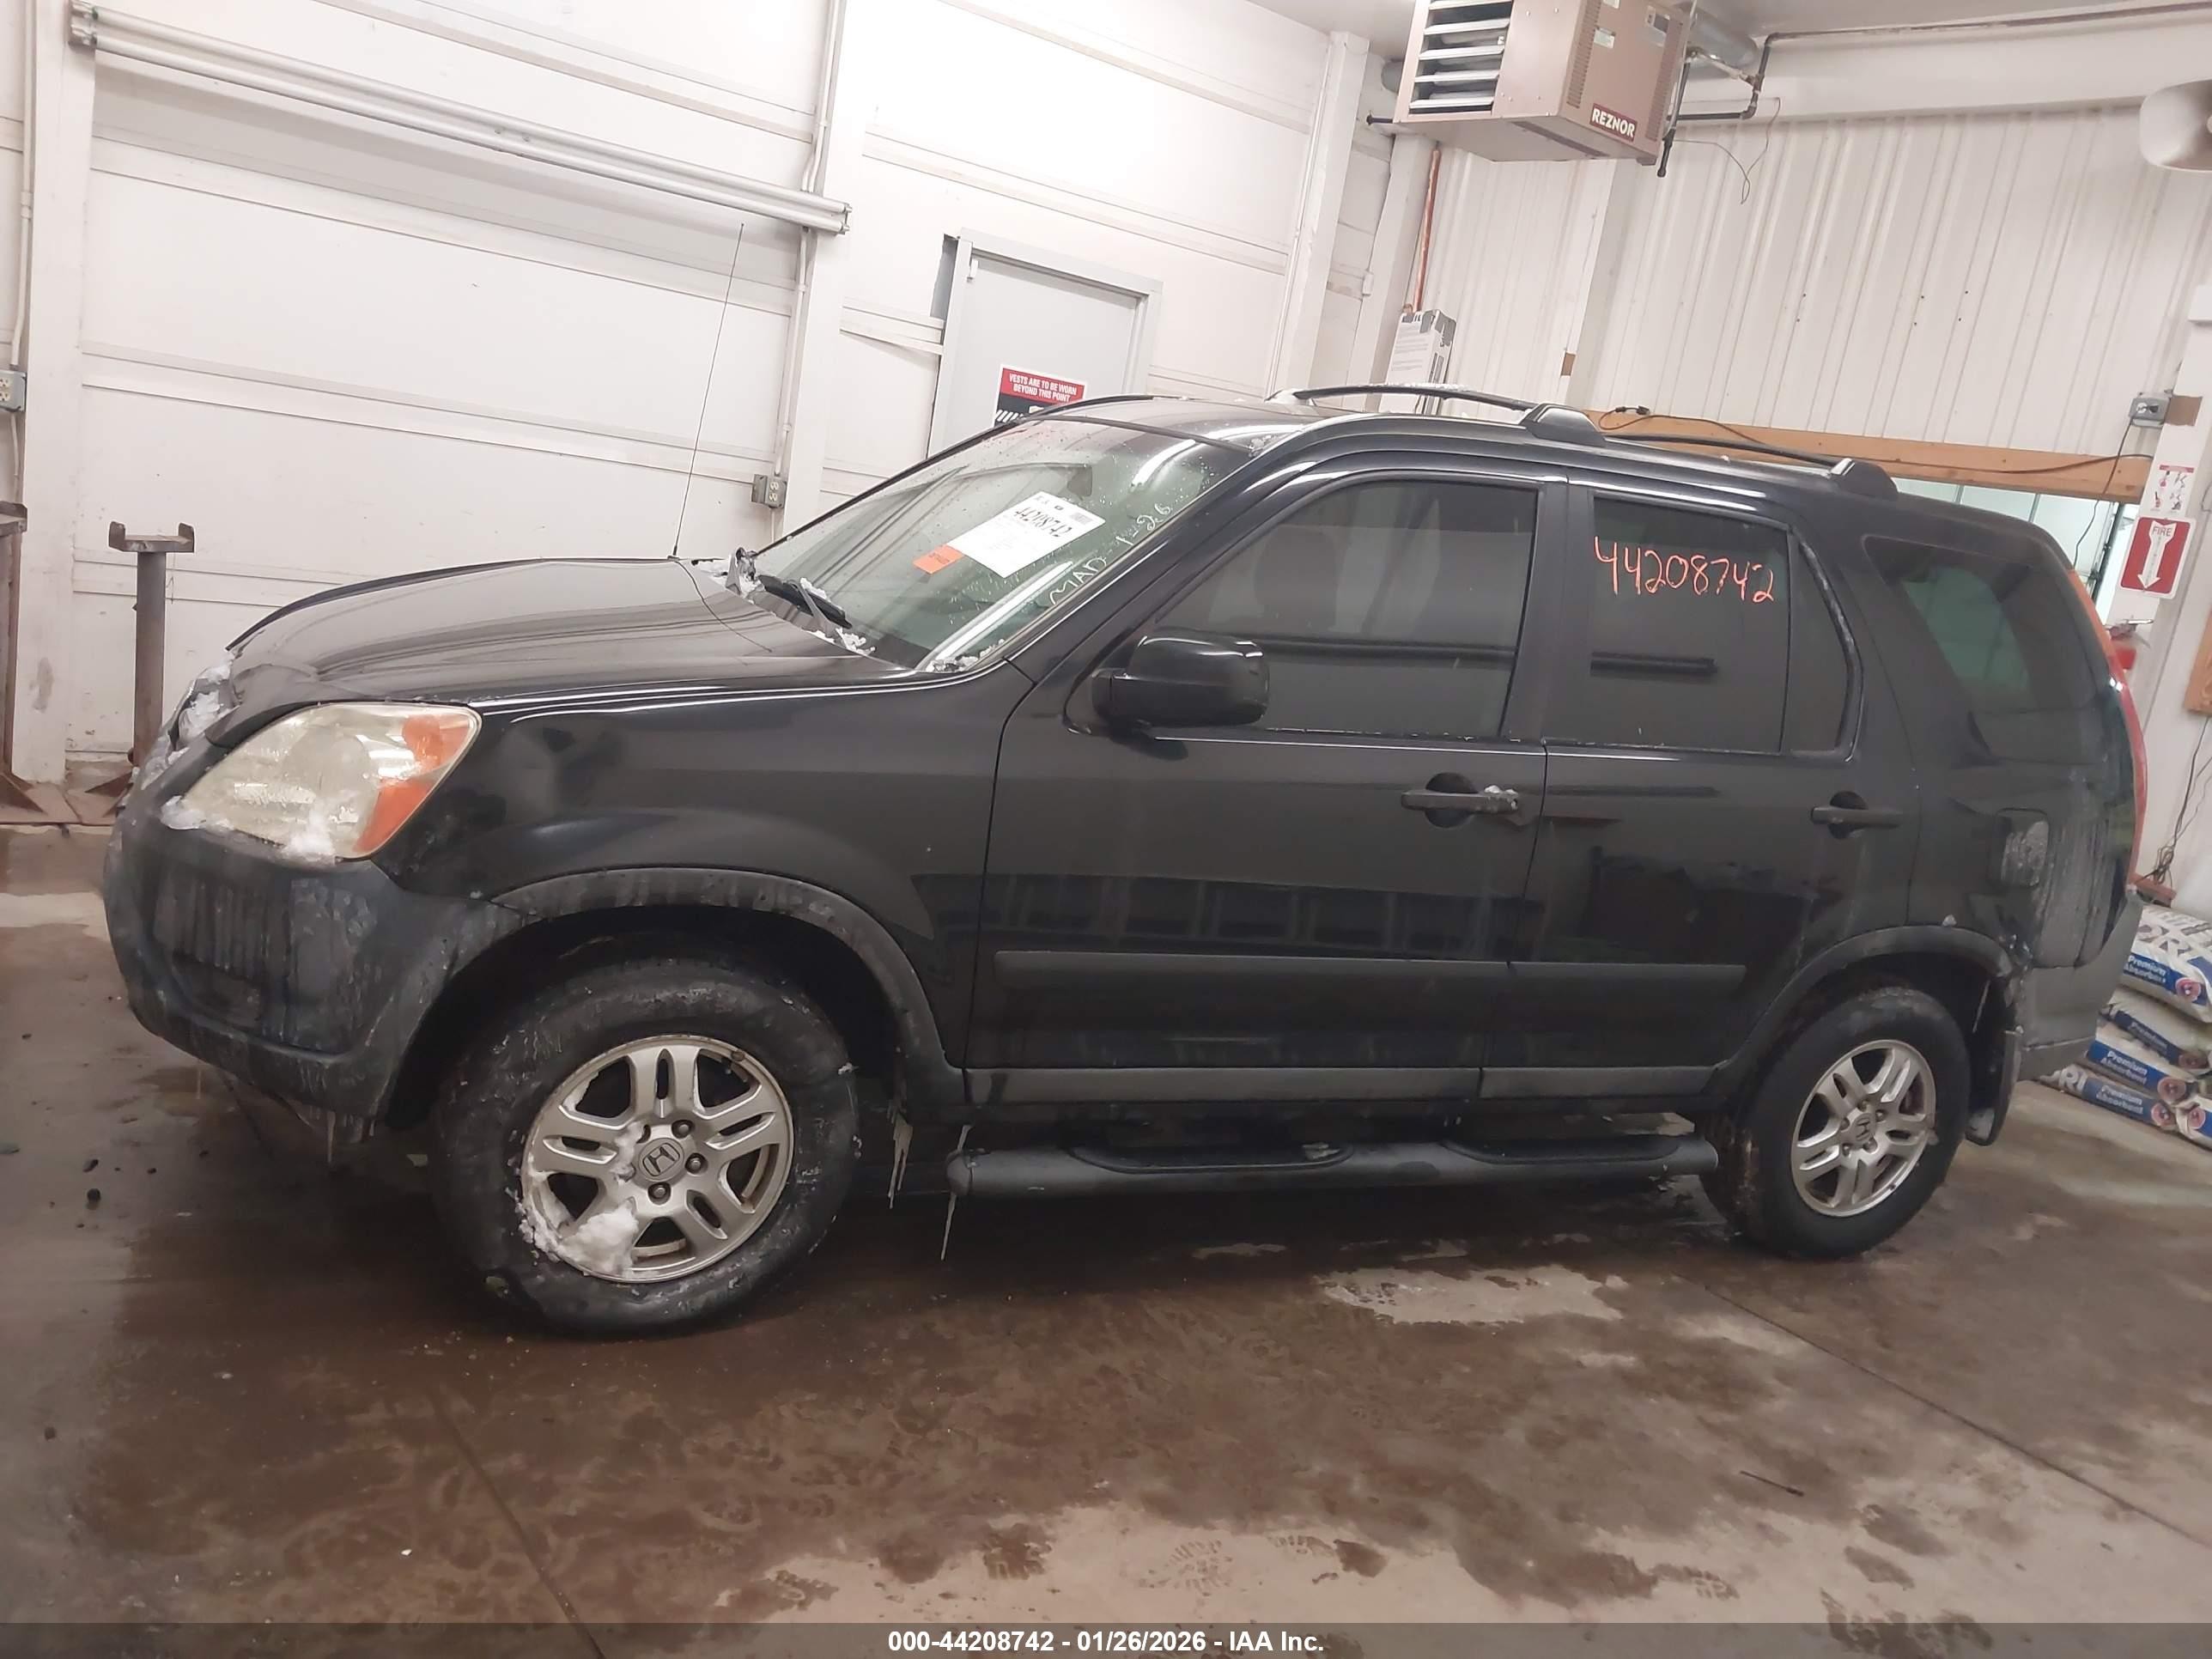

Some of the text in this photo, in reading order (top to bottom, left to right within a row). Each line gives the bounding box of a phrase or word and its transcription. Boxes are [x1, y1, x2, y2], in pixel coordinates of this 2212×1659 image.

[1591, 108, 1635, 137] REZNOR
[1009, 373, 1078, 395] VESTS ARE TO BE WORN
[1013, 383, 1071, 403] BEYOND THIS POINT
[1013, 507, 1073, 538] 44208742
[2152, 526, 2172, 537] FIRE
[1594, 536, 1774, 603] 44208742
[2128, 954, 2166, 976] Premium
[2107, 1050, 2148, 1075] Premium
[2101, 1085, 2142, 1106] Premium
